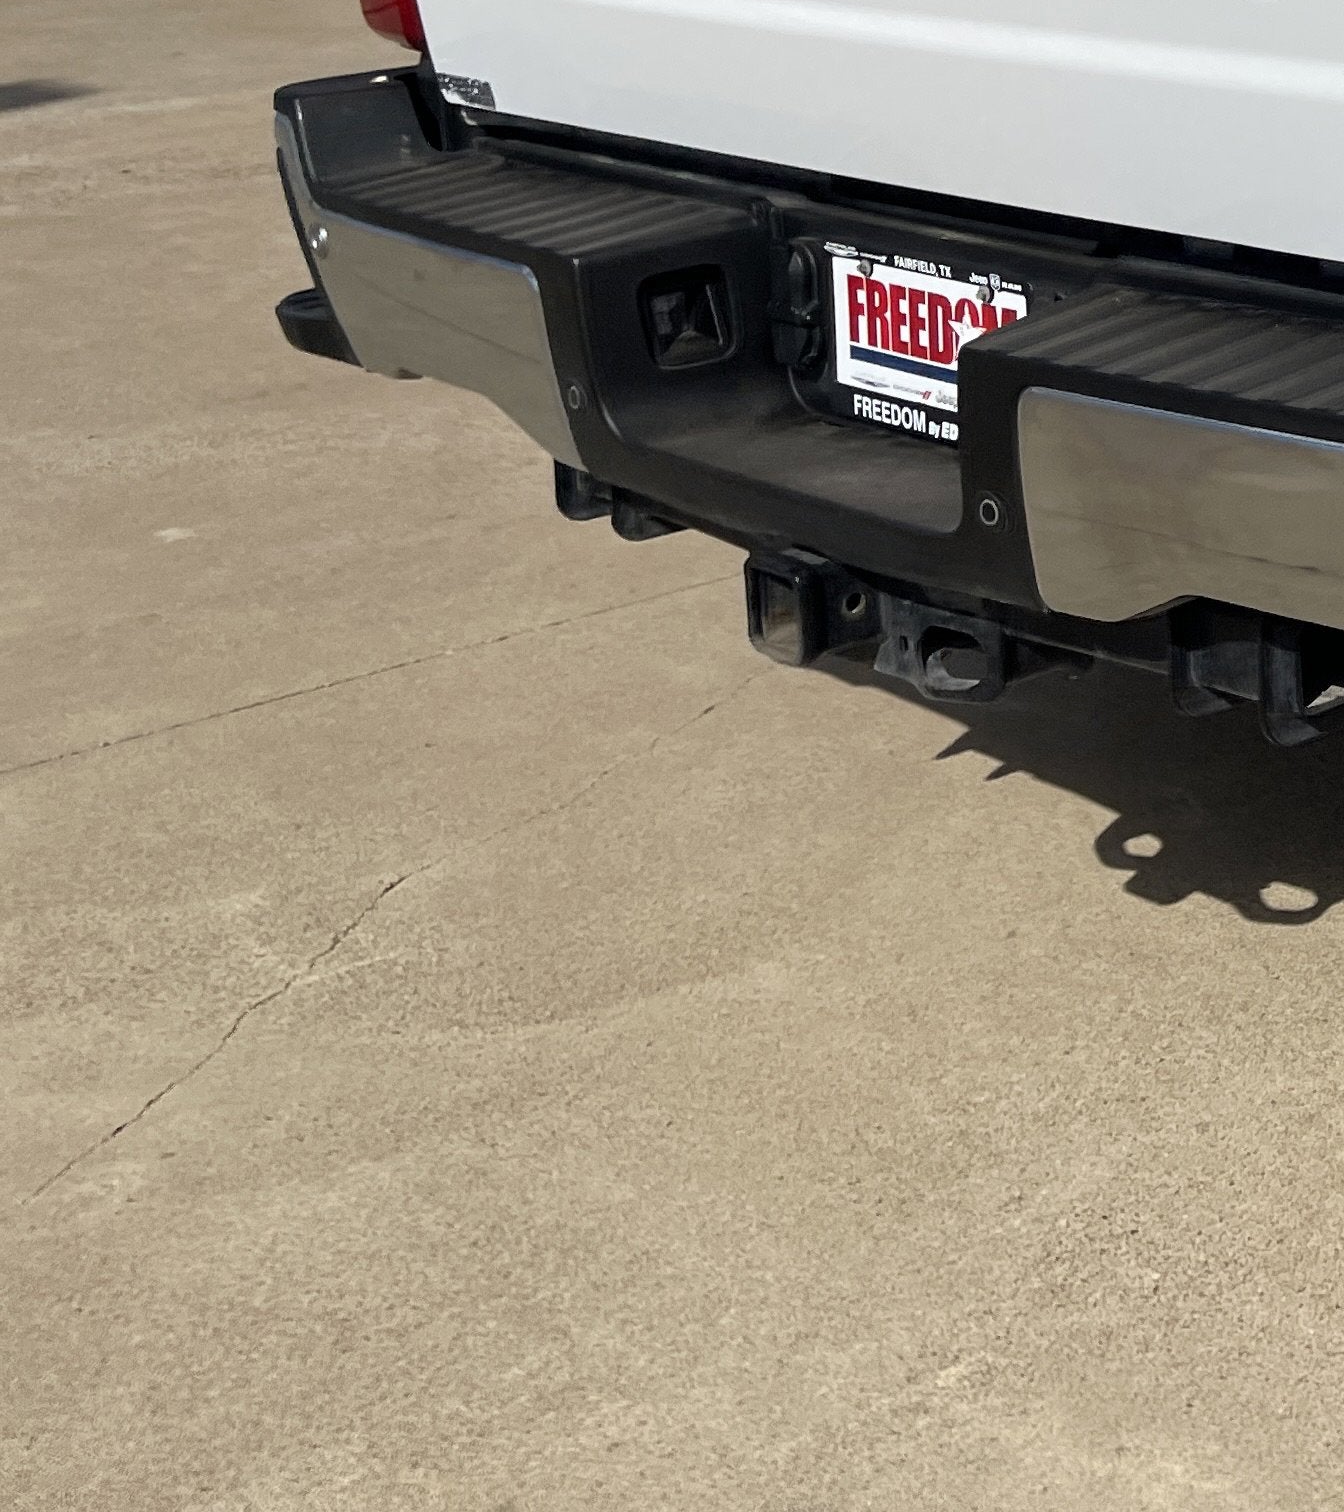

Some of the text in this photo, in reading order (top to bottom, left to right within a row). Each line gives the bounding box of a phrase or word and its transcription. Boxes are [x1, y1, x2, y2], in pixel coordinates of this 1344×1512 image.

[893, 255, 938, 278] FAIRFIELD,
[938, 264, 952, 278] TX
[853, 393, 926, 433] FREEDOM
[941, 421, 959, 441] ED
